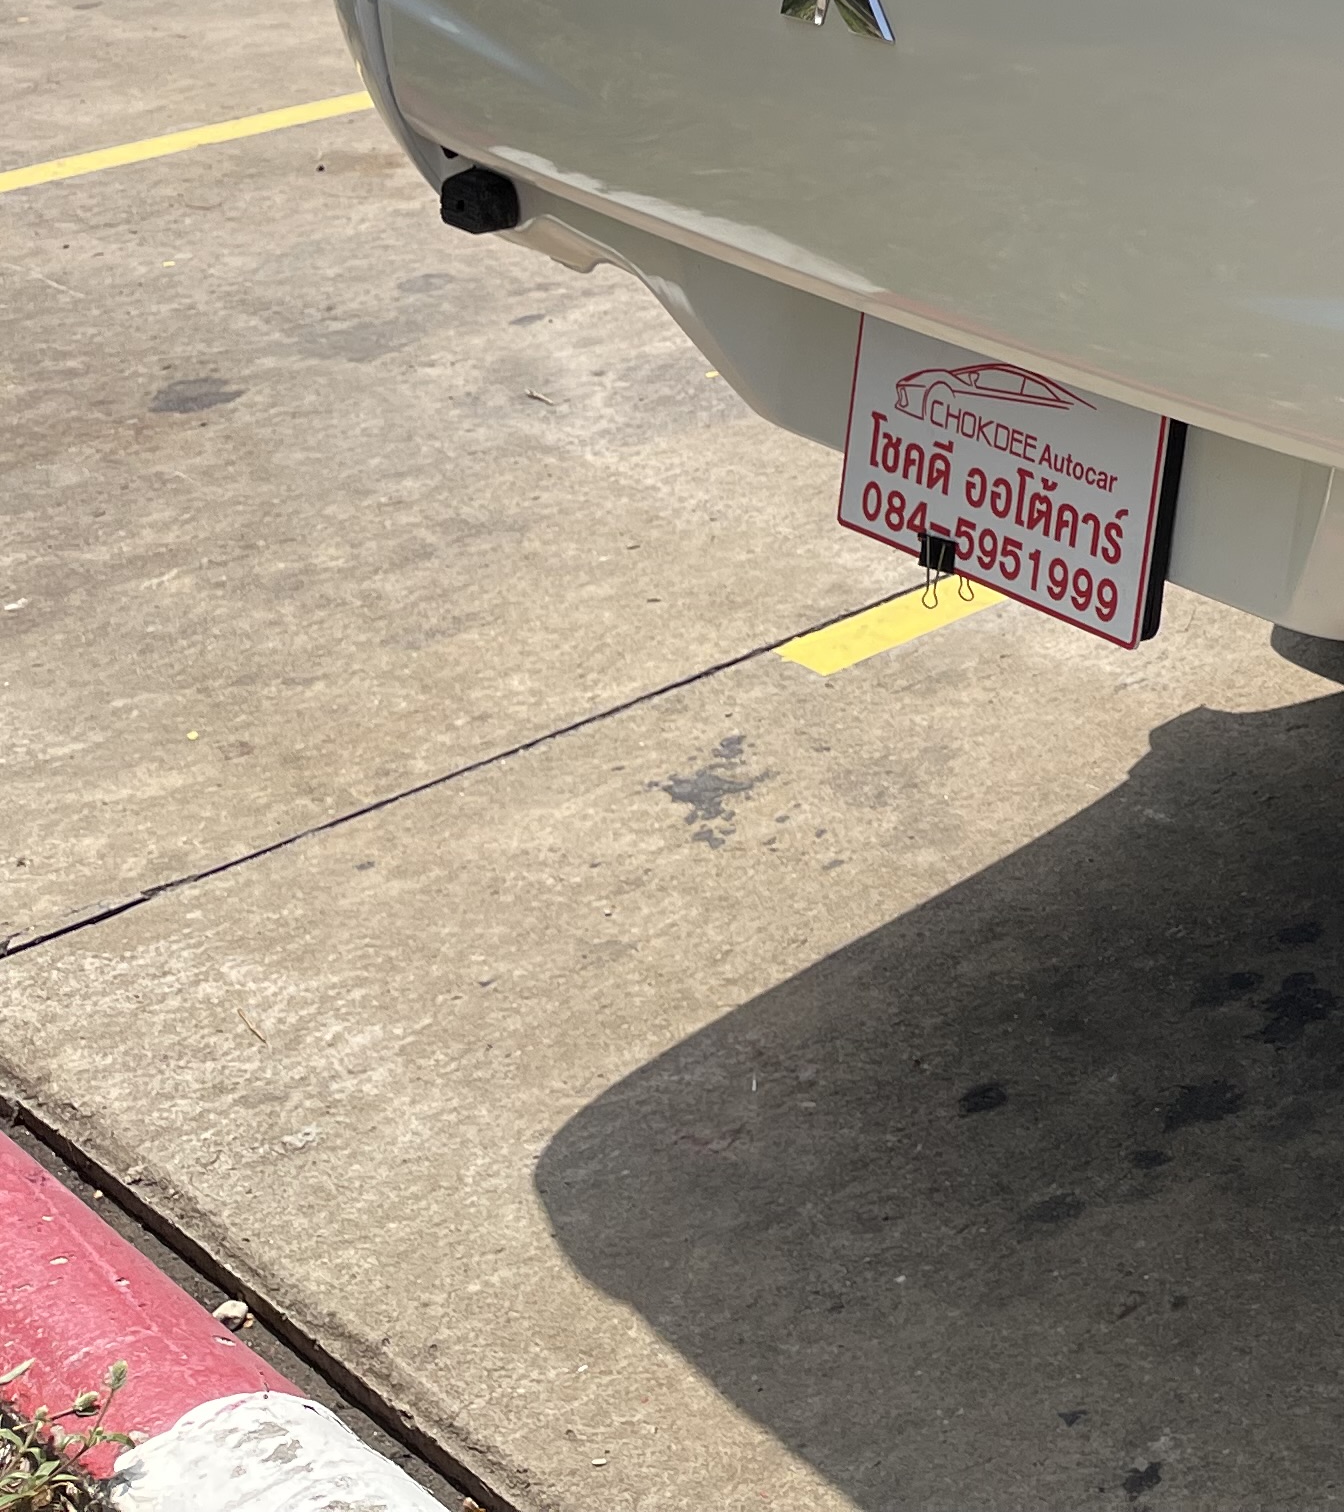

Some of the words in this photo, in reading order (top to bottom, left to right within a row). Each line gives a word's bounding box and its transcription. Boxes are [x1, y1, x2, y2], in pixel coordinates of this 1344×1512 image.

[869, 410, 954, 496] โชคดี
[965, 467, 1129, 565] ออโต้คาร์
[929, 399, 1038, 463] CHOKDEE
[1038, 444, 1118, 493] Autocar
[862, 481, 1119, 622] 084-5951999
